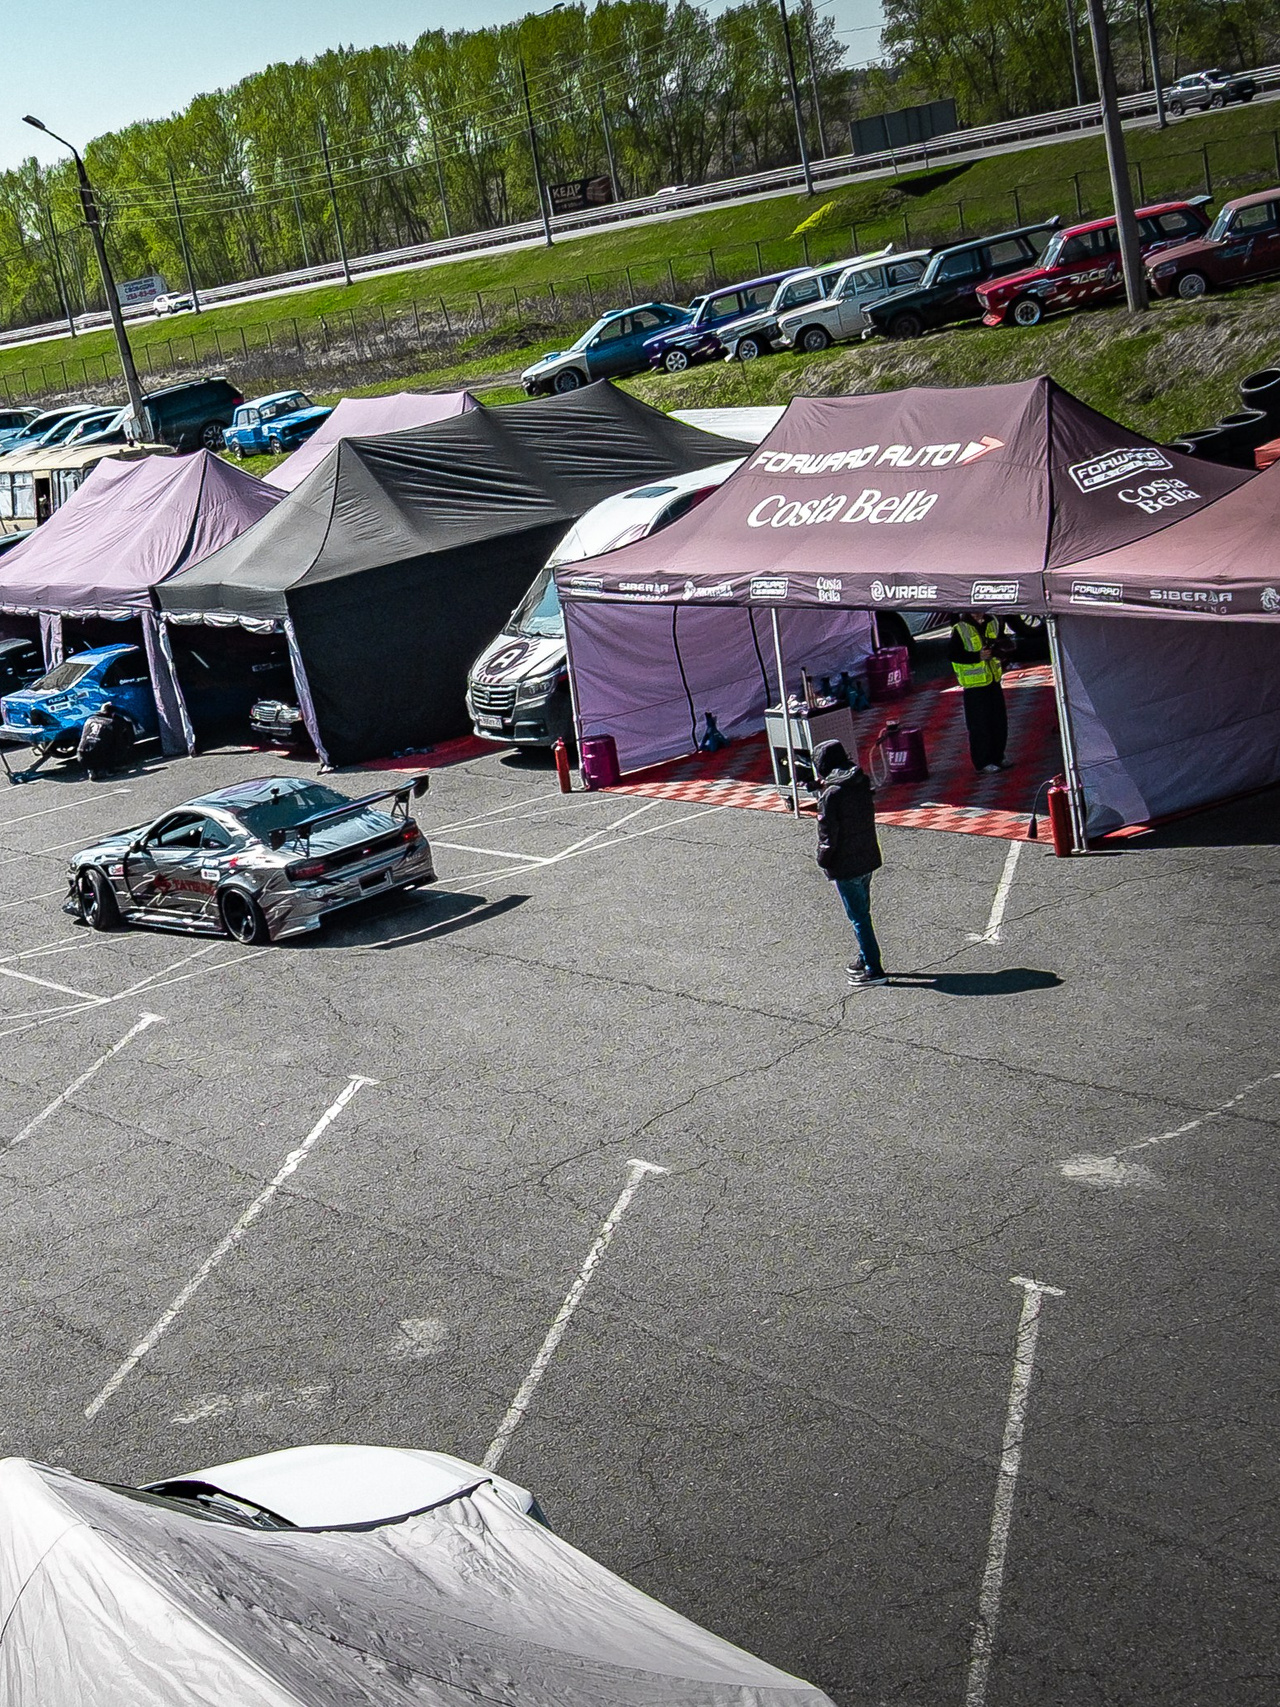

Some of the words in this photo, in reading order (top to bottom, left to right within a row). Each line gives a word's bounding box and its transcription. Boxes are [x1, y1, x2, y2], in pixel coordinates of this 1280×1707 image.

[552, 183, 581, 199] КЕДР
[748, 444, 880, 474] FORWARD
[874, 443, 962, 467] AUTO
[1077, 452, 1160, 479] FORWARD
[1118, 478, 1189, 503] Costa
[747, 492, 848, 528] Costa
[839, 489, 939, 524] Bella
[1136, 489, 1202, 514] Bella
[816, 577, 842, 590] Costa
[883, 585, 938, 599] VIRAGE
[1074, 585, 1120, 596] FORWARD
[818, 589, 840, 602] Bella
[490, 648, 523, 668] A
